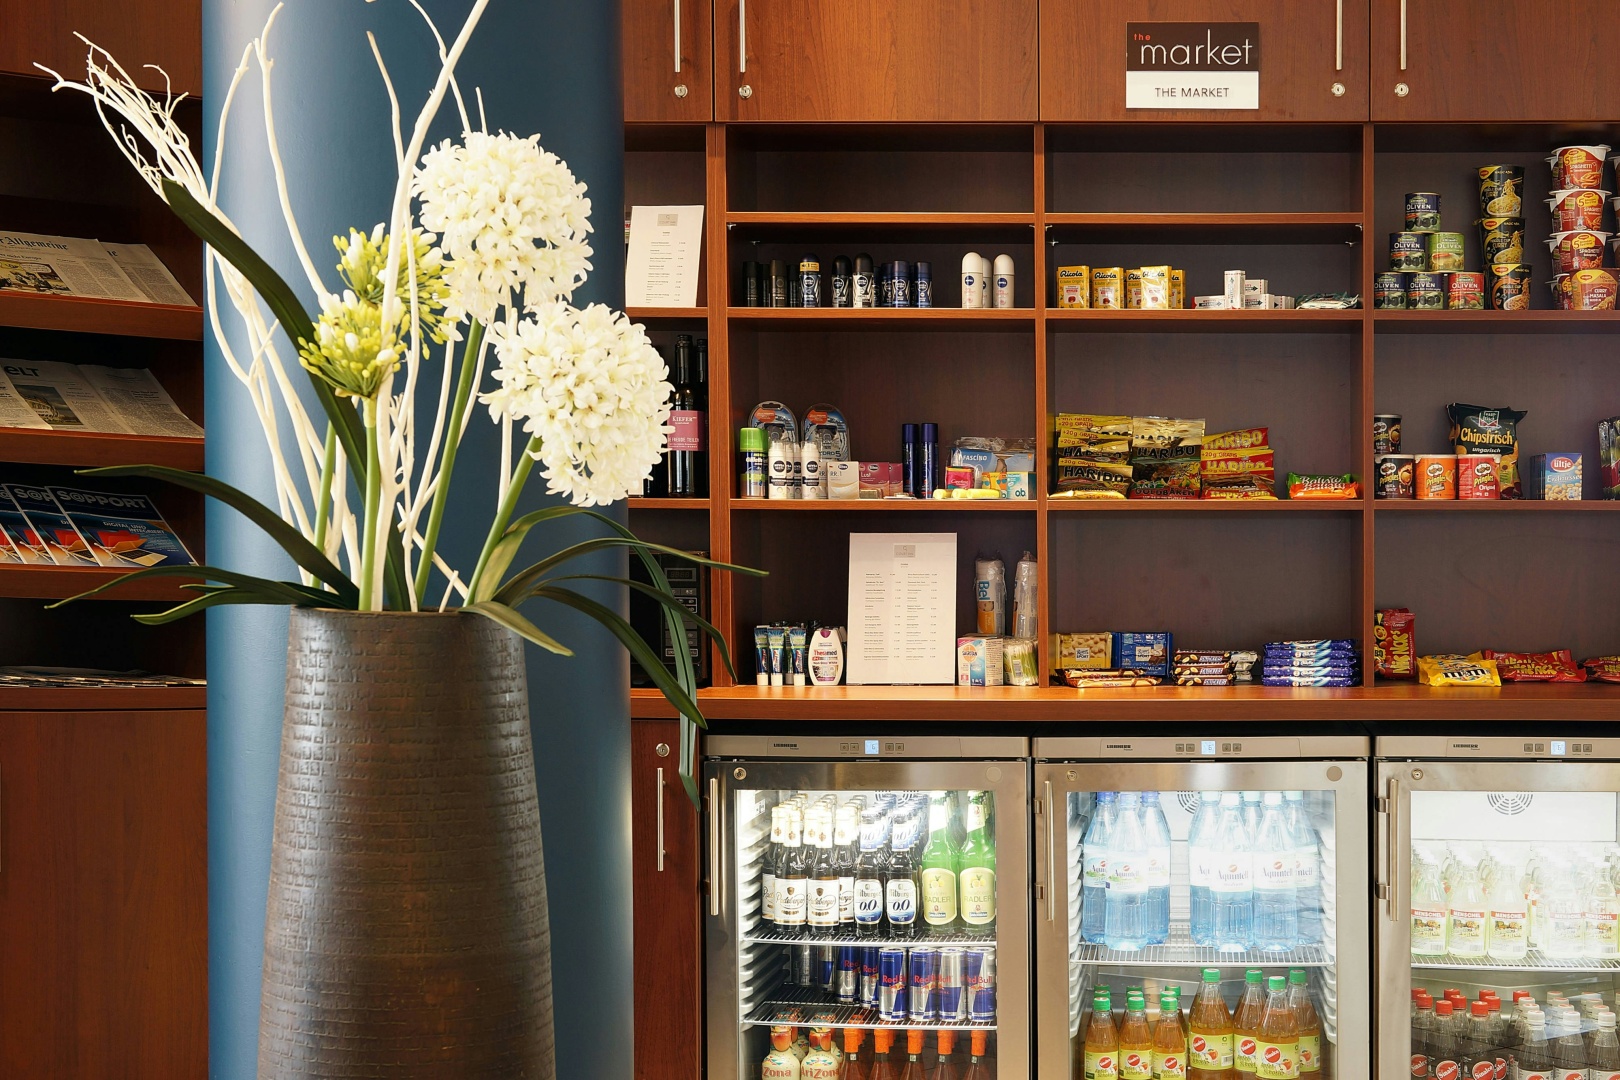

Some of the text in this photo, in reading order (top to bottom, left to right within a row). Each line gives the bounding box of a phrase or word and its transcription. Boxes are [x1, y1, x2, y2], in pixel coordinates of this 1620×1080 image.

[1133, 33, 1151, 41] the
[1140, 28, 1253, 66] market
[1154, 87, 1230, 98] THE MARKET
[4, 236, 69, 250] Allgemeine
[1059, 270, 1083, 279] Ricola
[1094, 271, 1117, 279] Ricola
[1203, 430, 1263, 450] HARIBO
[1460, 427, 1513, 445] Chipsfrisch
[1137, 446, 1196, 459] HARIBO
[1553, 459, 1572, 469] ültje
[1063, 466, 1125, 482] HARIBO
[1425, 474, 1446, 489] Pringles
[1473, 474, 1494, 488] Pringles
[978, 581, 991, 600] Bel
[924, 895, 952, 903] RADLER
[963, 895, 992, 903] RADLER
[862, 964, 878, 973] Red
[882, 974, 898, 983] Red
[914, 974, 930, 983] Red
[977, 975, 993, 984] Bull
[762, 1066, 792, 1077] Zona
[1437, 1064, 1458, 1078] Sinalco
[1474, 1065, 1494, 1080] Sinalco
